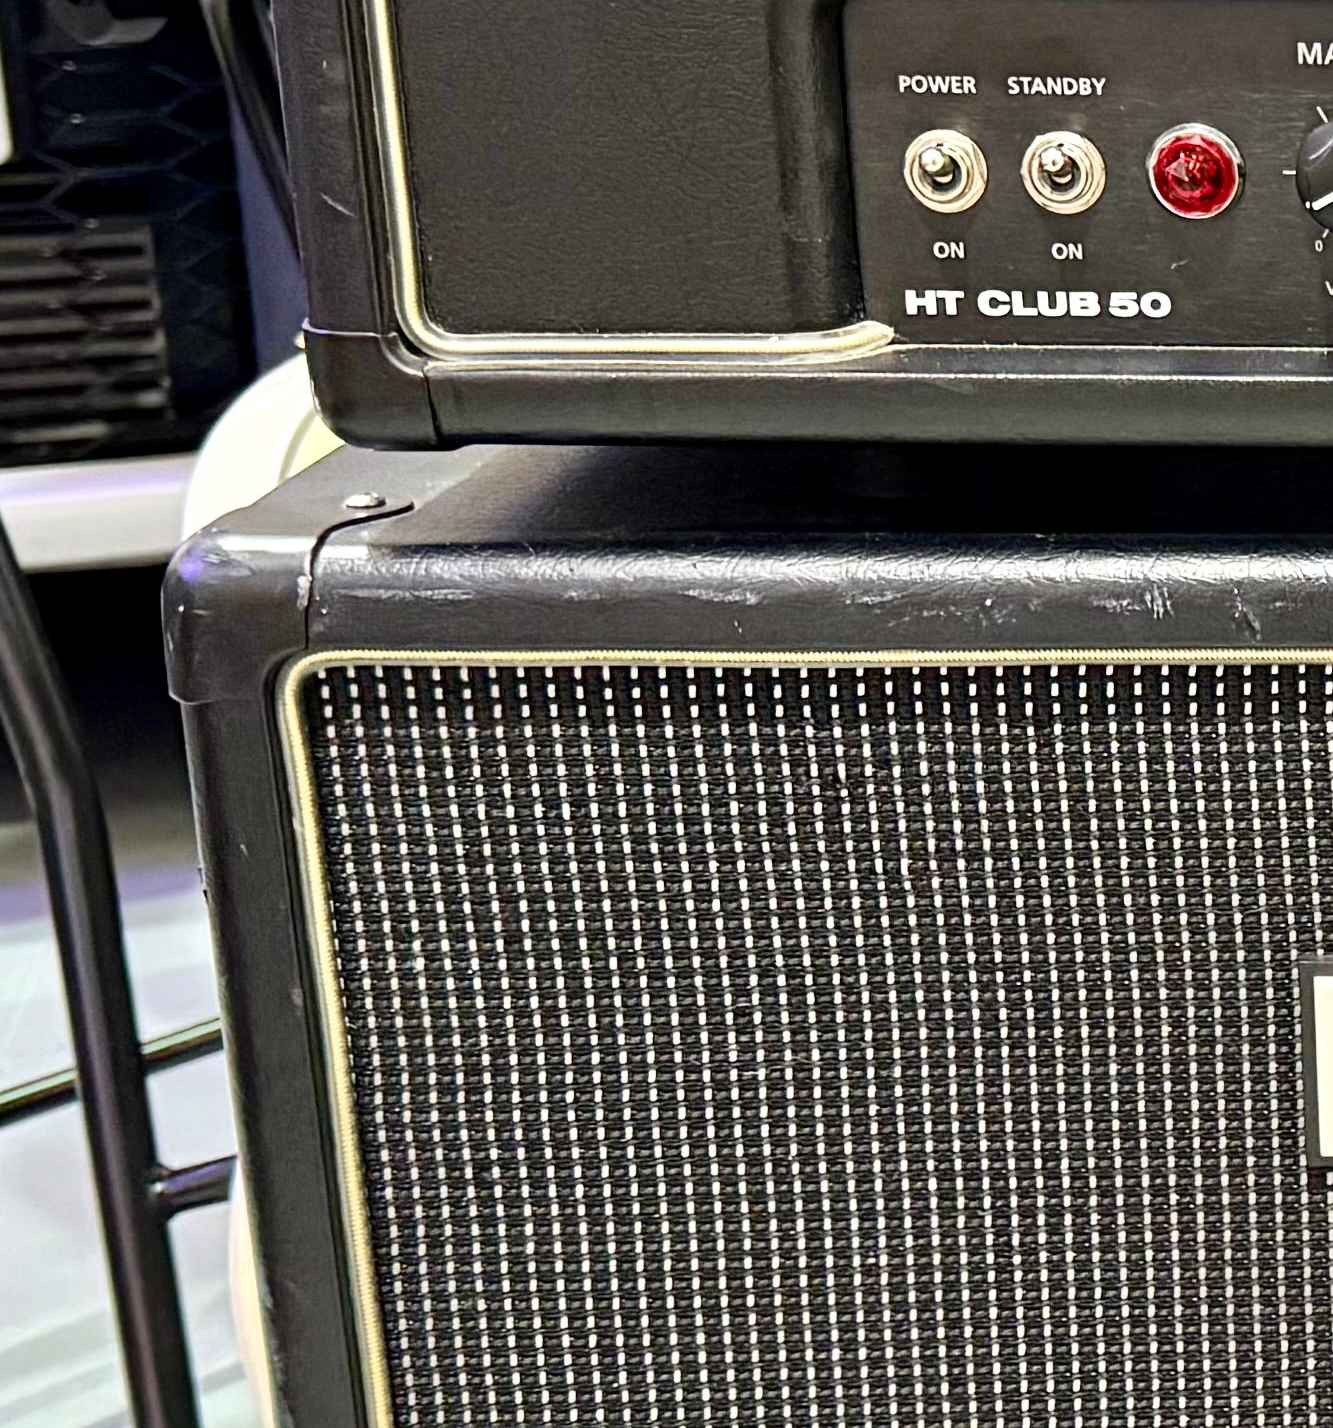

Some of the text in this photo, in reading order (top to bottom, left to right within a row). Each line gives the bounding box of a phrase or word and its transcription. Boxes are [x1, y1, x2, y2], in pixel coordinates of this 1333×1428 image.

[898, 74, 977, 94] POWER
[1007, 76, 1106, 96] STANDBY
[932, 241, 965, 259] ON
[1051, 242, 1083, 260] ON
[1314, 240, 1323, 253] 0
[904, 289, 1172, 318] HT CLUB 50
